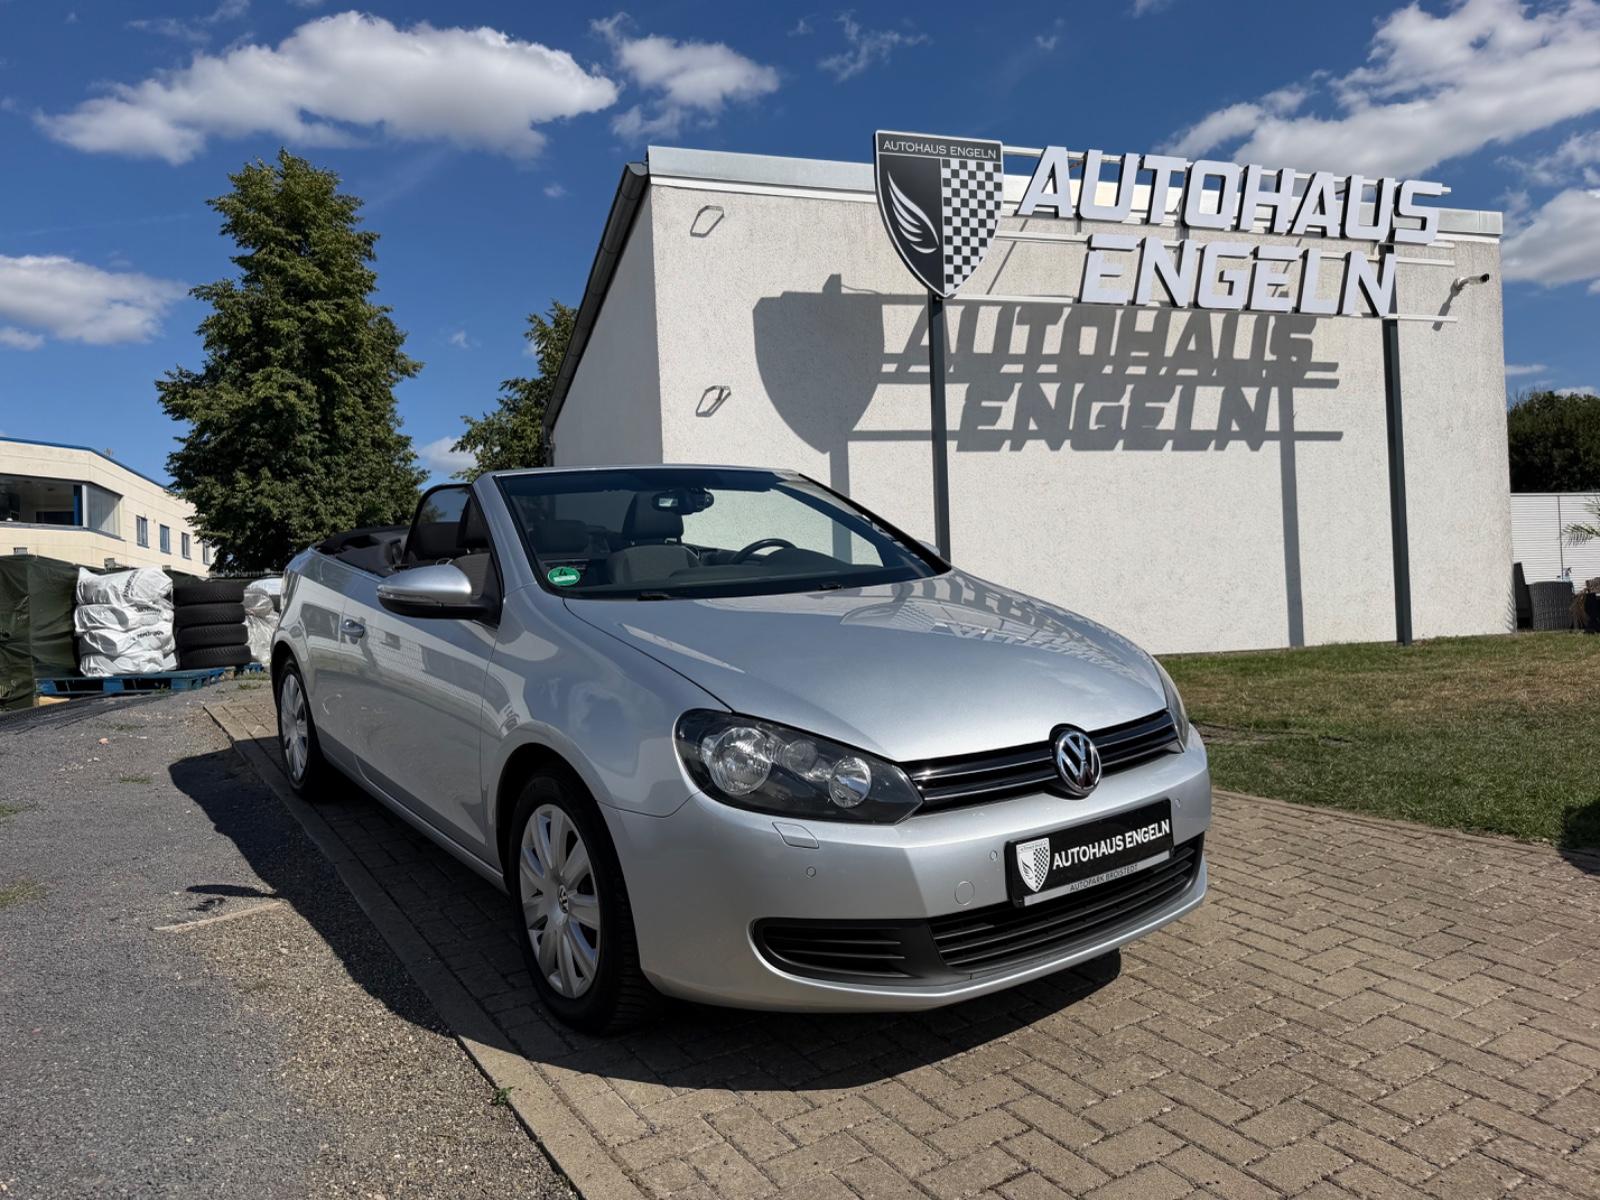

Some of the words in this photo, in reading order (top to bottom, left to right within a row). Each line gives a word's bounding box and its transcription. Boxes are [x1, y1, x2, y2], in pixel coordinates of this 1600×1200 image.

[883, 140, 947, 154] AUTOHAUS
[950, 146, 996, 159] ENGELN
[1016, 146, 1443, 244] AUTOHAUS
[1079, 233, 1397, 316] ENGELN
[1053, 836, 1123, 870] AUTOHAUS
[1125, 819, 1170, 848] ENGELN
